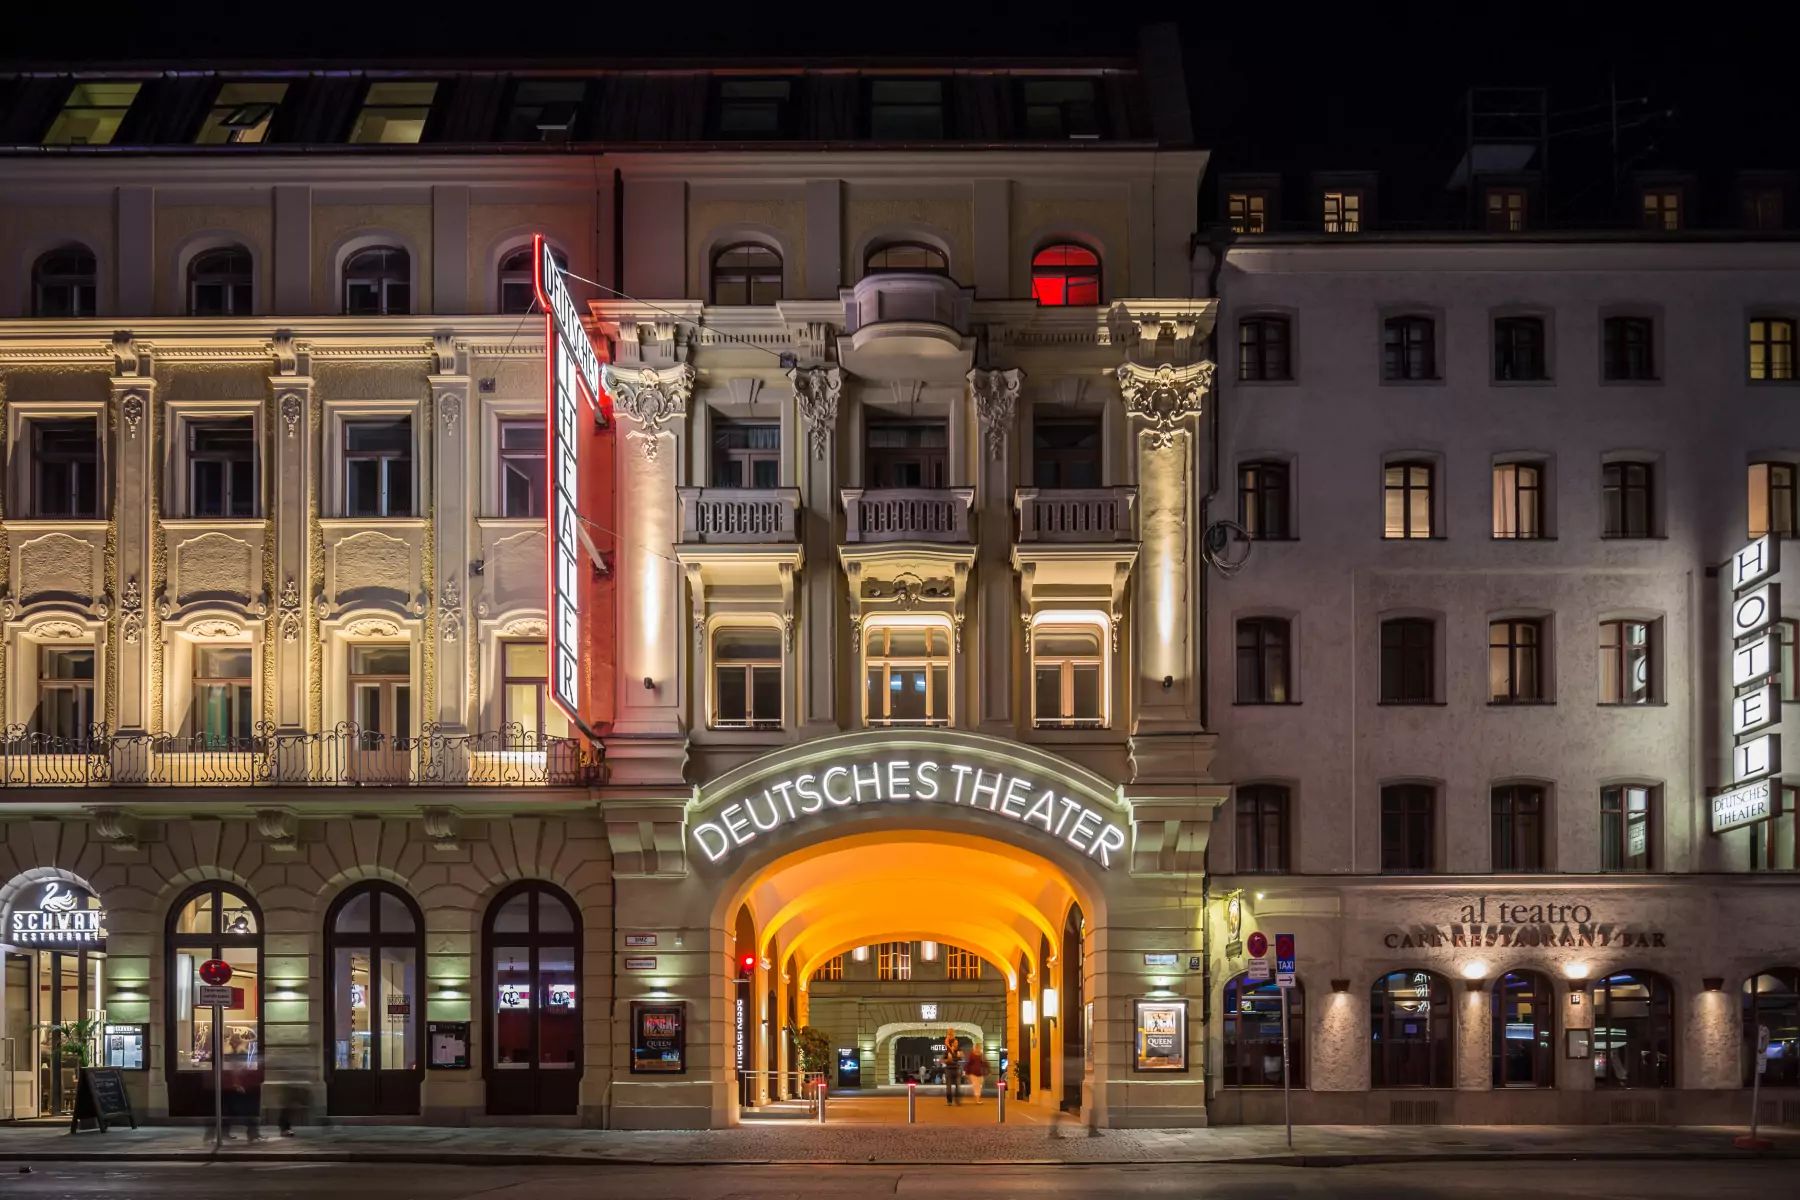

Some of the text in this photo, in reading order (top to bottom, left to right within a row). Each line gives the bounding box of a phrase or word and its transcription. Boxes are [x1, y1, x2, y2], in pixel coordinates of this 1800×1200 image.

[546, 250, 598, 396] DEUTSCHES
[559, 340, 575, 704] THEATER
[1736, 541, 1765, 776] HOTEL
[1714, 784, 1769, 812] DEUTSCHES
[693, 760, 1125, 870] DEUTSCHES THEATER
[1719, 802, 1766, 826] THEATER
[13, 912, 100, 930] SCHWAN
[1460, 897, 1592, 924] al teatro
[13, 932, 99, 941] RESTAURANT
[1453, 932, 1613, 949] RESTAURANT
[1621, 931, 1667, 949] BAR
[1278, 961, 1294, 970] TAXI
[1572, 995, 1580, 1003] 15
[646, 1040, 672, 1050] QUEEN
[1147, 1038, 1173, 1048] QUEEN
